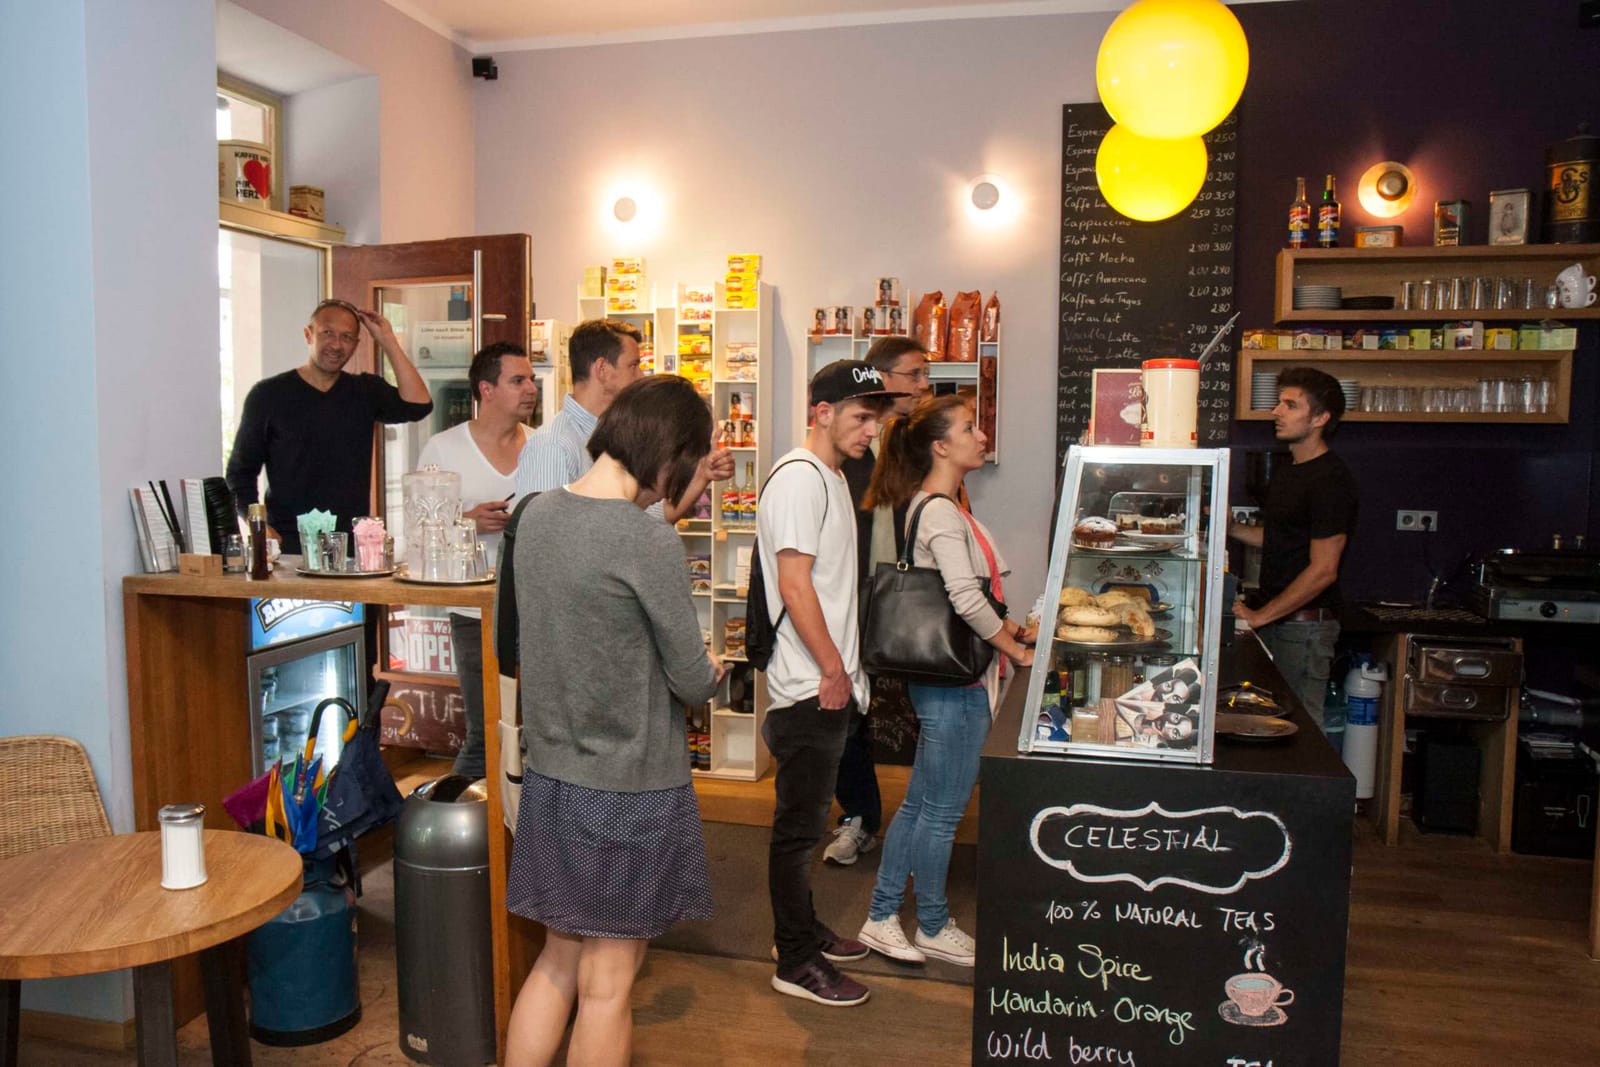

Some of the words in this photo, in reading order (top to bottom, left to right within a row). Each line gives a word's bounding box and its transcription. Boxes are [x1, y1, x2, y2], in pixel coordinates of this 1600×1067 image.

[1065, 144, 1096, 158] Espres
[1190, 208, 1210, 219] 250
[1063, 217, 1132, 231] Cappuccino
[1063, 234, 1088, 245] Flat
[1092, 232, 1126, 245] White
[1099, 252, 1135, 263] Mocha
[1095, 272, 1147, 284] Americano
[1103, 312, 1121, 323] lait
[1107, 331, 1142, 343] Latte
[1105, 347, 1142, 360] Latte
[1059, 385, 1078, 394] Hot
[1058, 400, 1076, 409] Hot
[1059, 414, 1076, 423] Hot
[1064, 825, 1233, 851] CELESTIAL
[1046, 902, 1073, 924] 100
[1115, 902, 1203, 928] NATURAL
[1216, 907, 1276, 932] TEAS
[1002, 936, 1065, 973] India
[1077, 943, 1153, 991] Spice
[1113, 996, 1196, 1045] Orange
[986, 1027, 1053, 1060] Wild
[1068, 1036, 1136, 1067] berry
